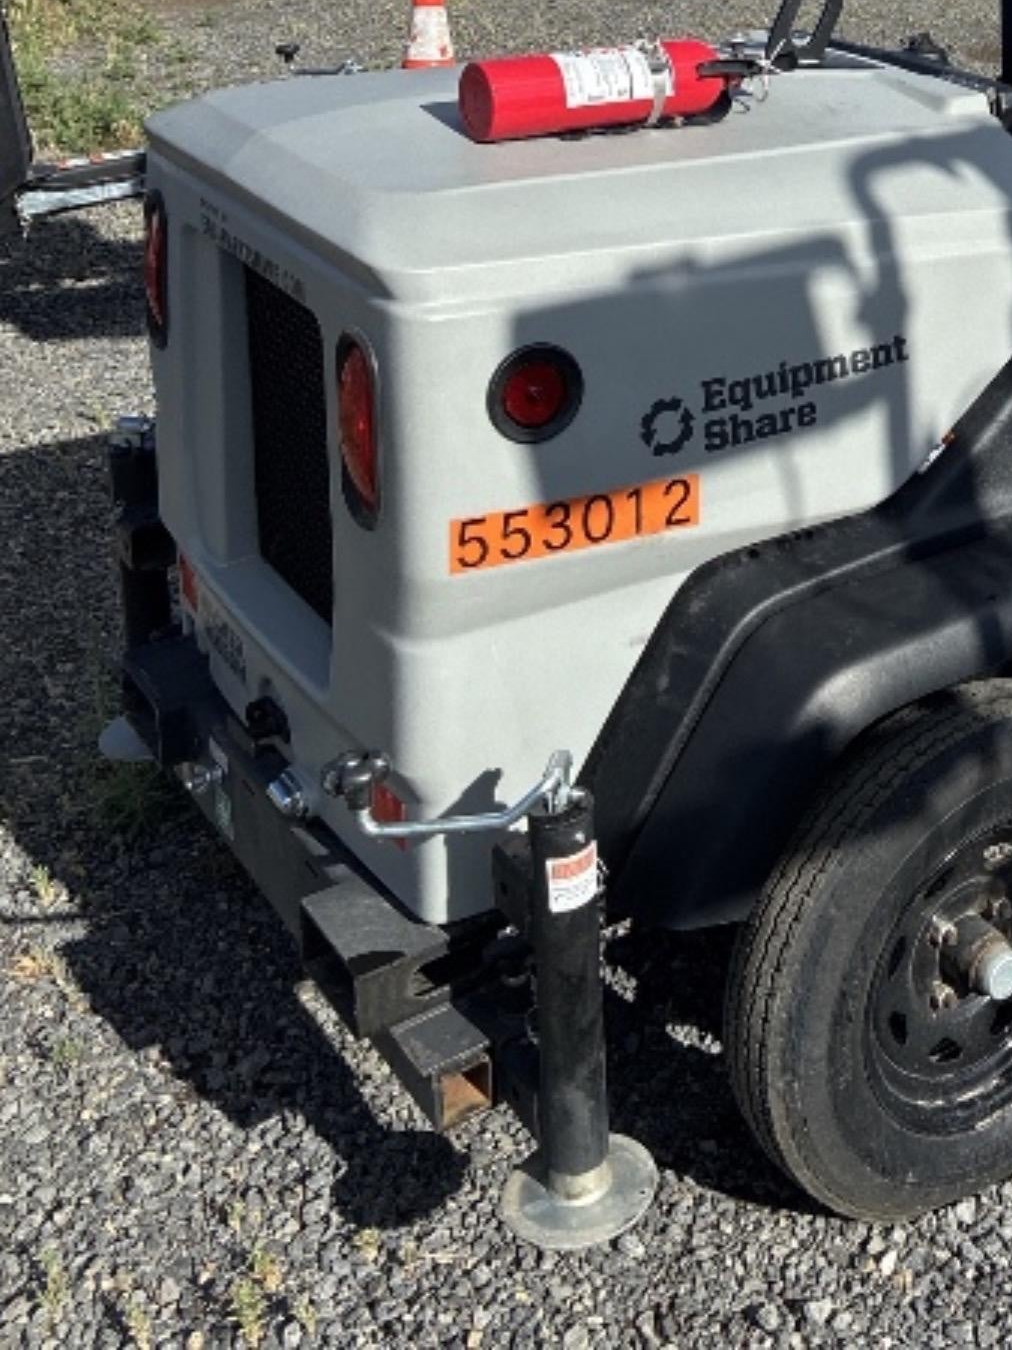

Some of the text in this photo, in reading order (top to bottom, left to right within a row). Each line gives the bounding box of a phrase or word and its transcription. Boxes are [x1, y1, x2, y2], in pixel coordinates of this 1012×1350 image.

[701, 336, 910, 415] Equipment
[703, 401, 818, 453] Share
[456, 478, 693, 569] 553012
